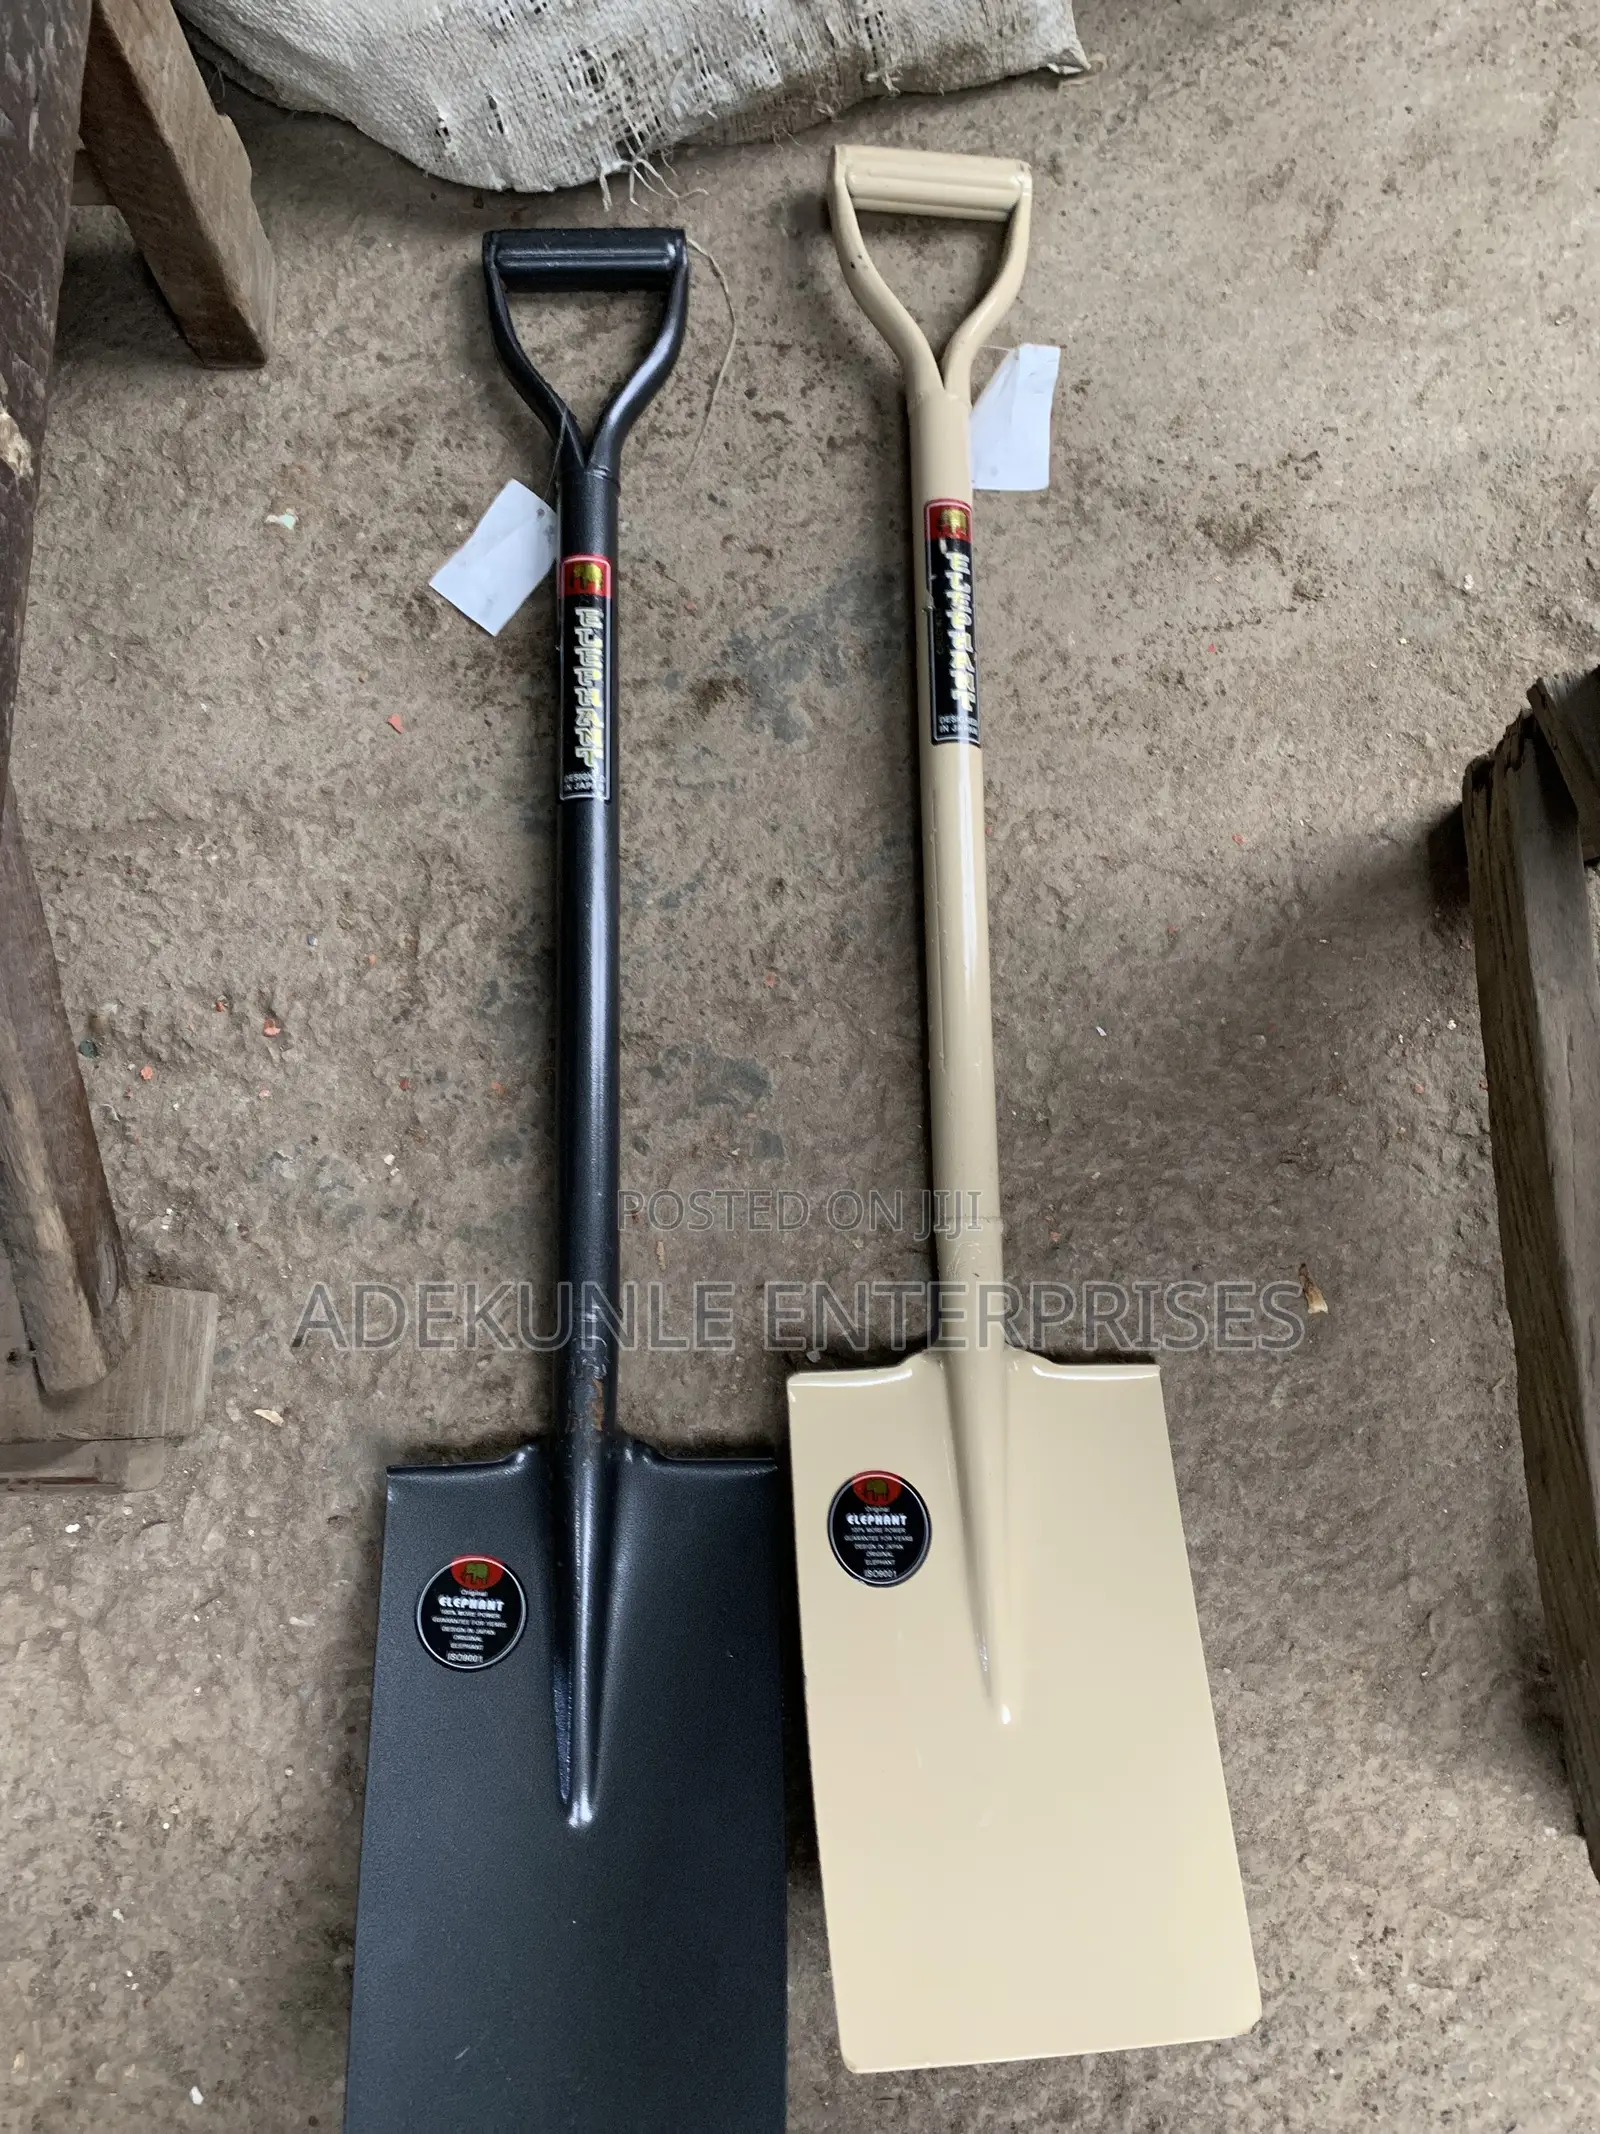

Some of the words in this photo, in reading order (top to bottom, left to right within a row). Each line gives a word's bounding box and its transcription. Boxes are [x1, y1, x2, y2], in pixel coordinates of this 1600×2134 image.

[945, 551, 976, 712] ELEPHANT
[574, 607, 605, 769] ELEPHANT
[846, 1513, 907, 1525] ELEPHANT
[864, 1568, 897, 1578] ISO9001
[437, 1595, 504, 1611] ELEPHANT
[447, 1652, 483, 1663] ISO9001
